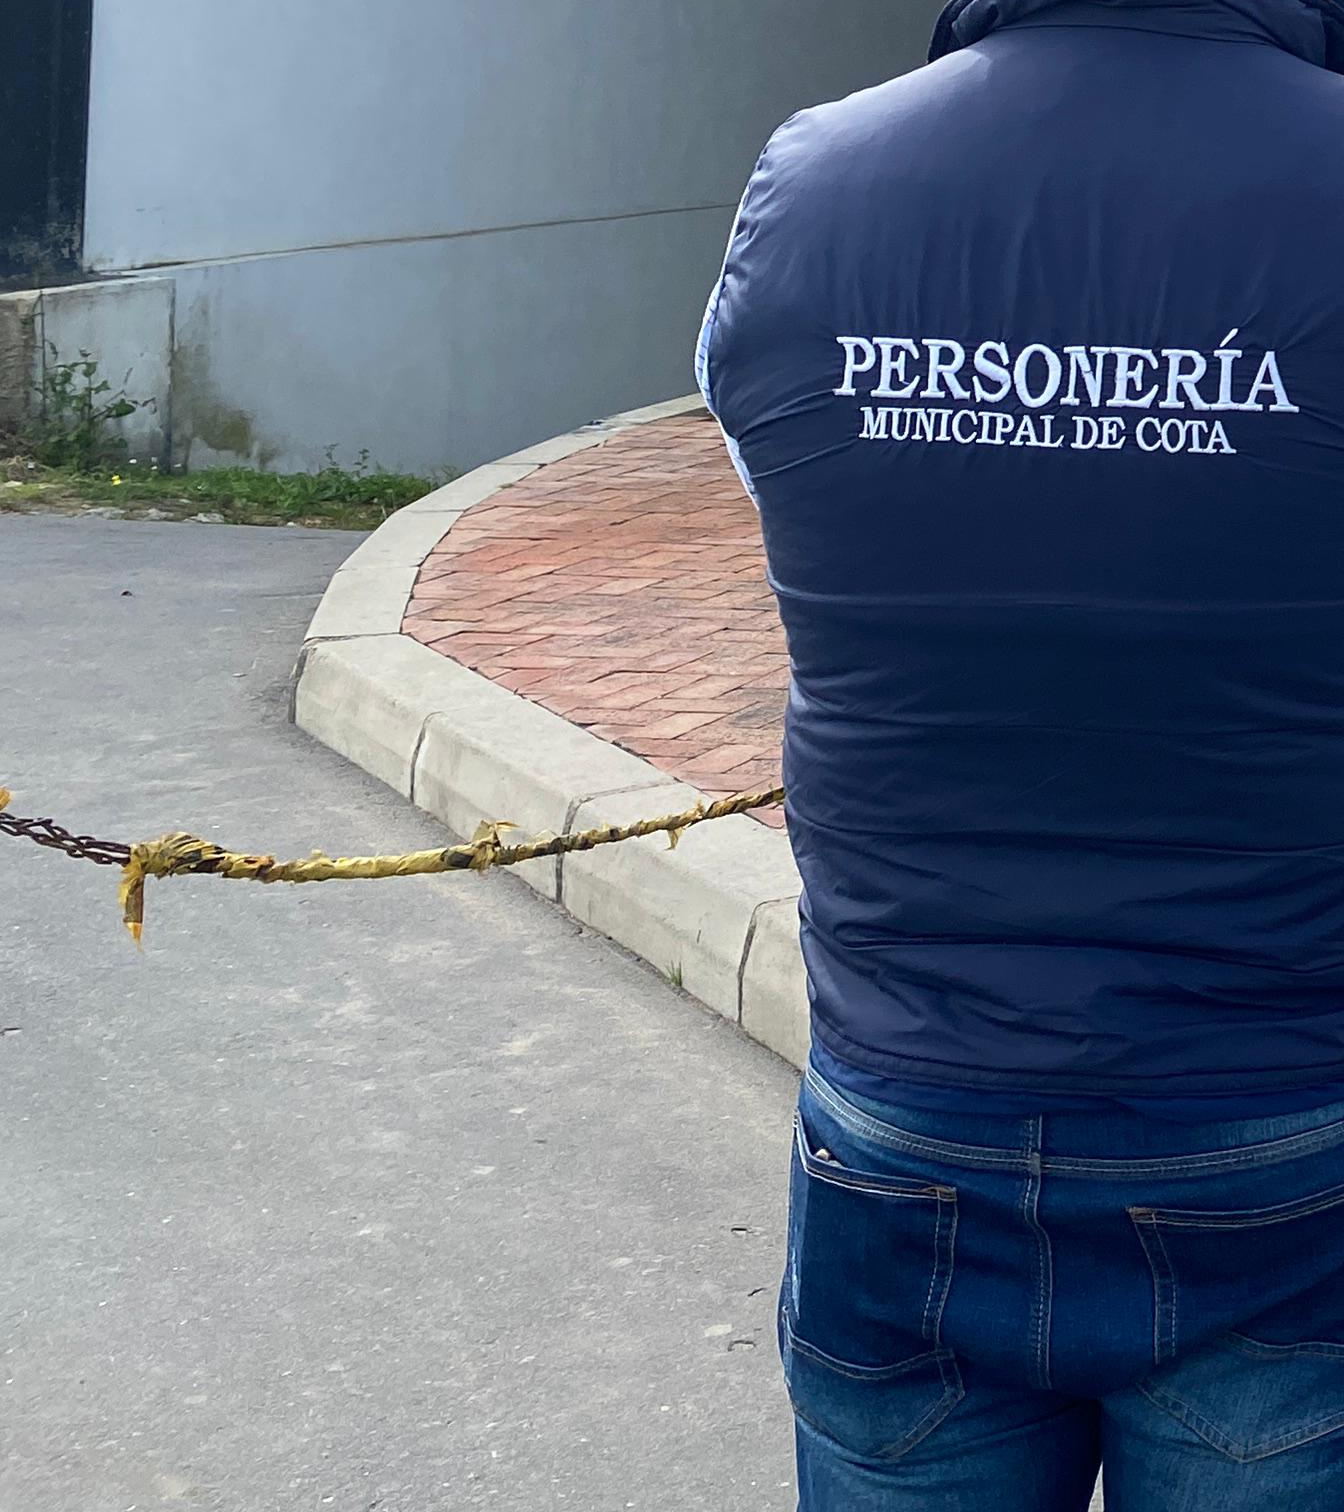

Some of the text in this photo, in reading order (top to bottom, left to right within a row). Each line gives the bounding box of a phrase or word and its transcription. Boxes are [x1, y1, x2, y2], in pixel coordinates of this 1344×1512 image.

[832, 328, 1300, 413] PERSONERÍA
[858, 406, 1237, 454] MUNICIPAL DE COTA
